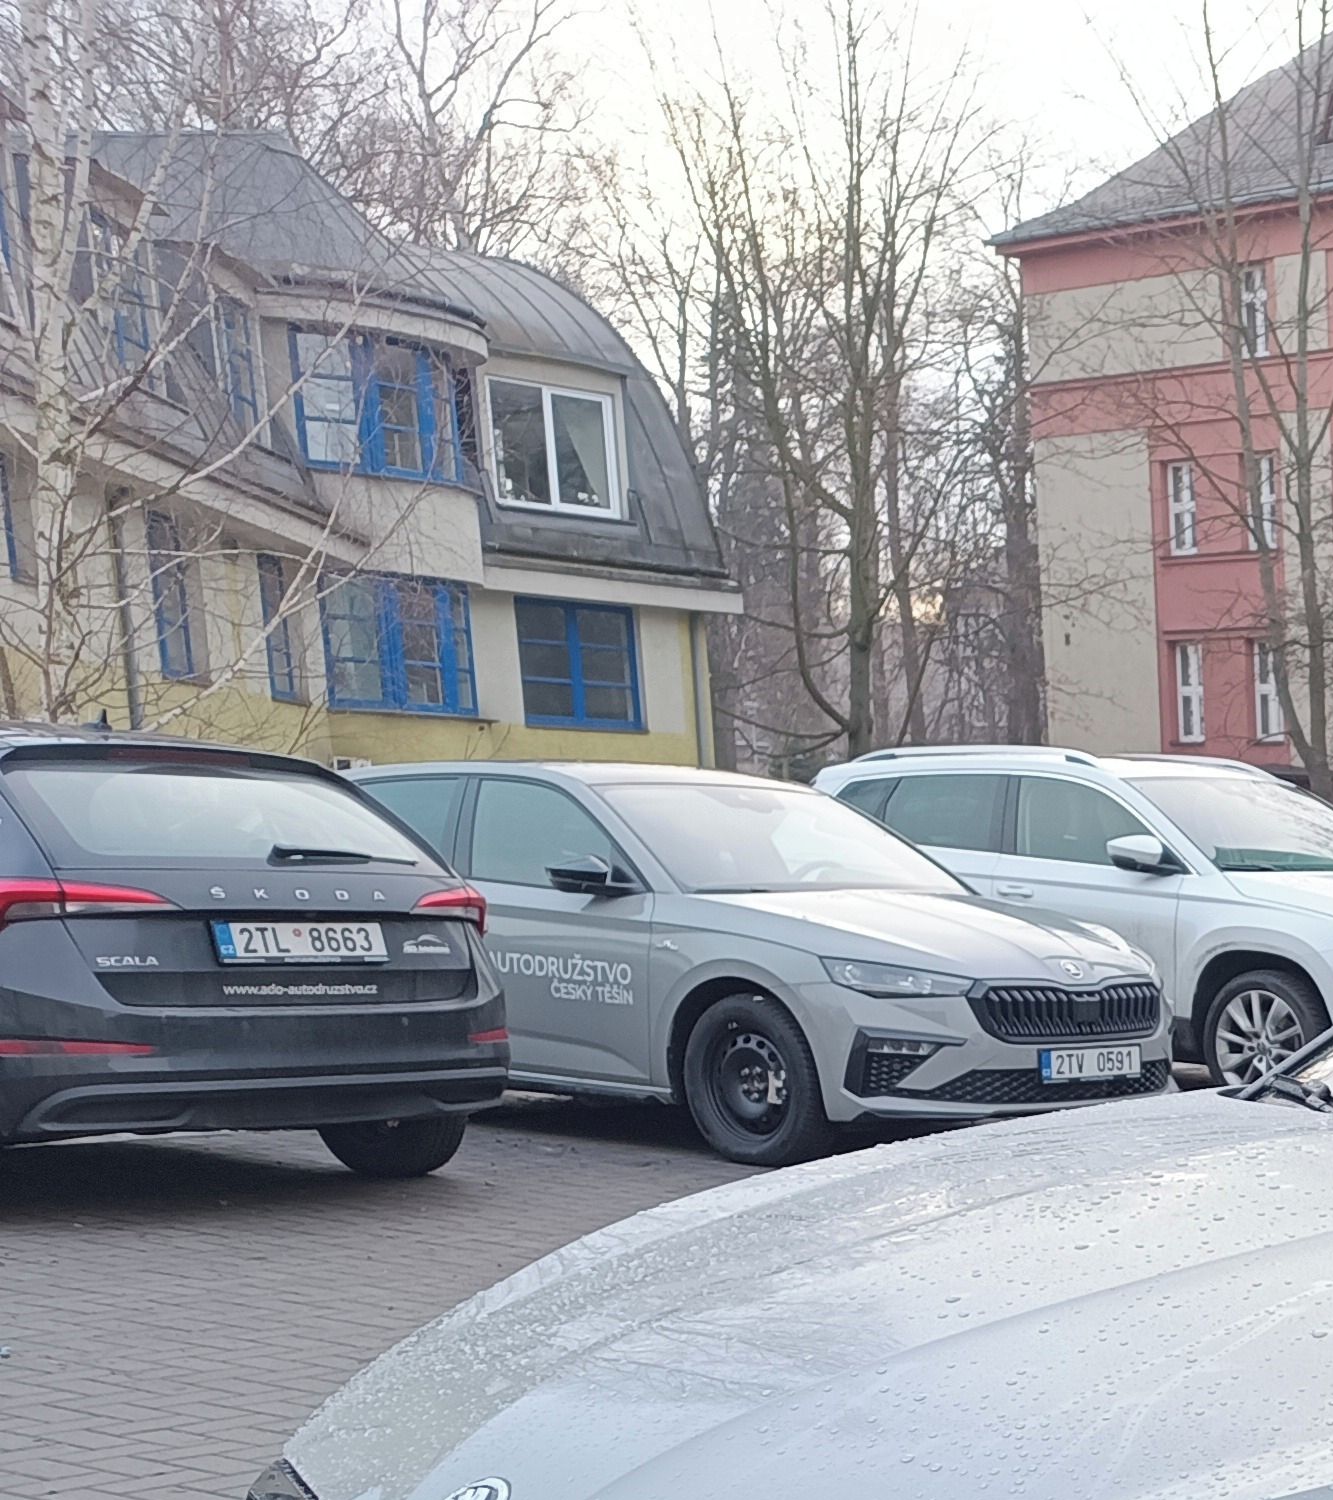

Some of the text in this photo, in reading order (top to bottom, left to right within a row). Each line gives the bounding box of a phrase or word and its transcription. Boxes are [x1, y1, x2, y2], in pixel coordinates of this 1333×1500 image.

[238, 927, 373, 954] 2TL 8663
[96, 956, 159, 967] SCALA
[550, 978, 634, 1005] ČESKÝ TĚŠÍN
[1055, 1050, 1132, 1074] 2TV 0591
